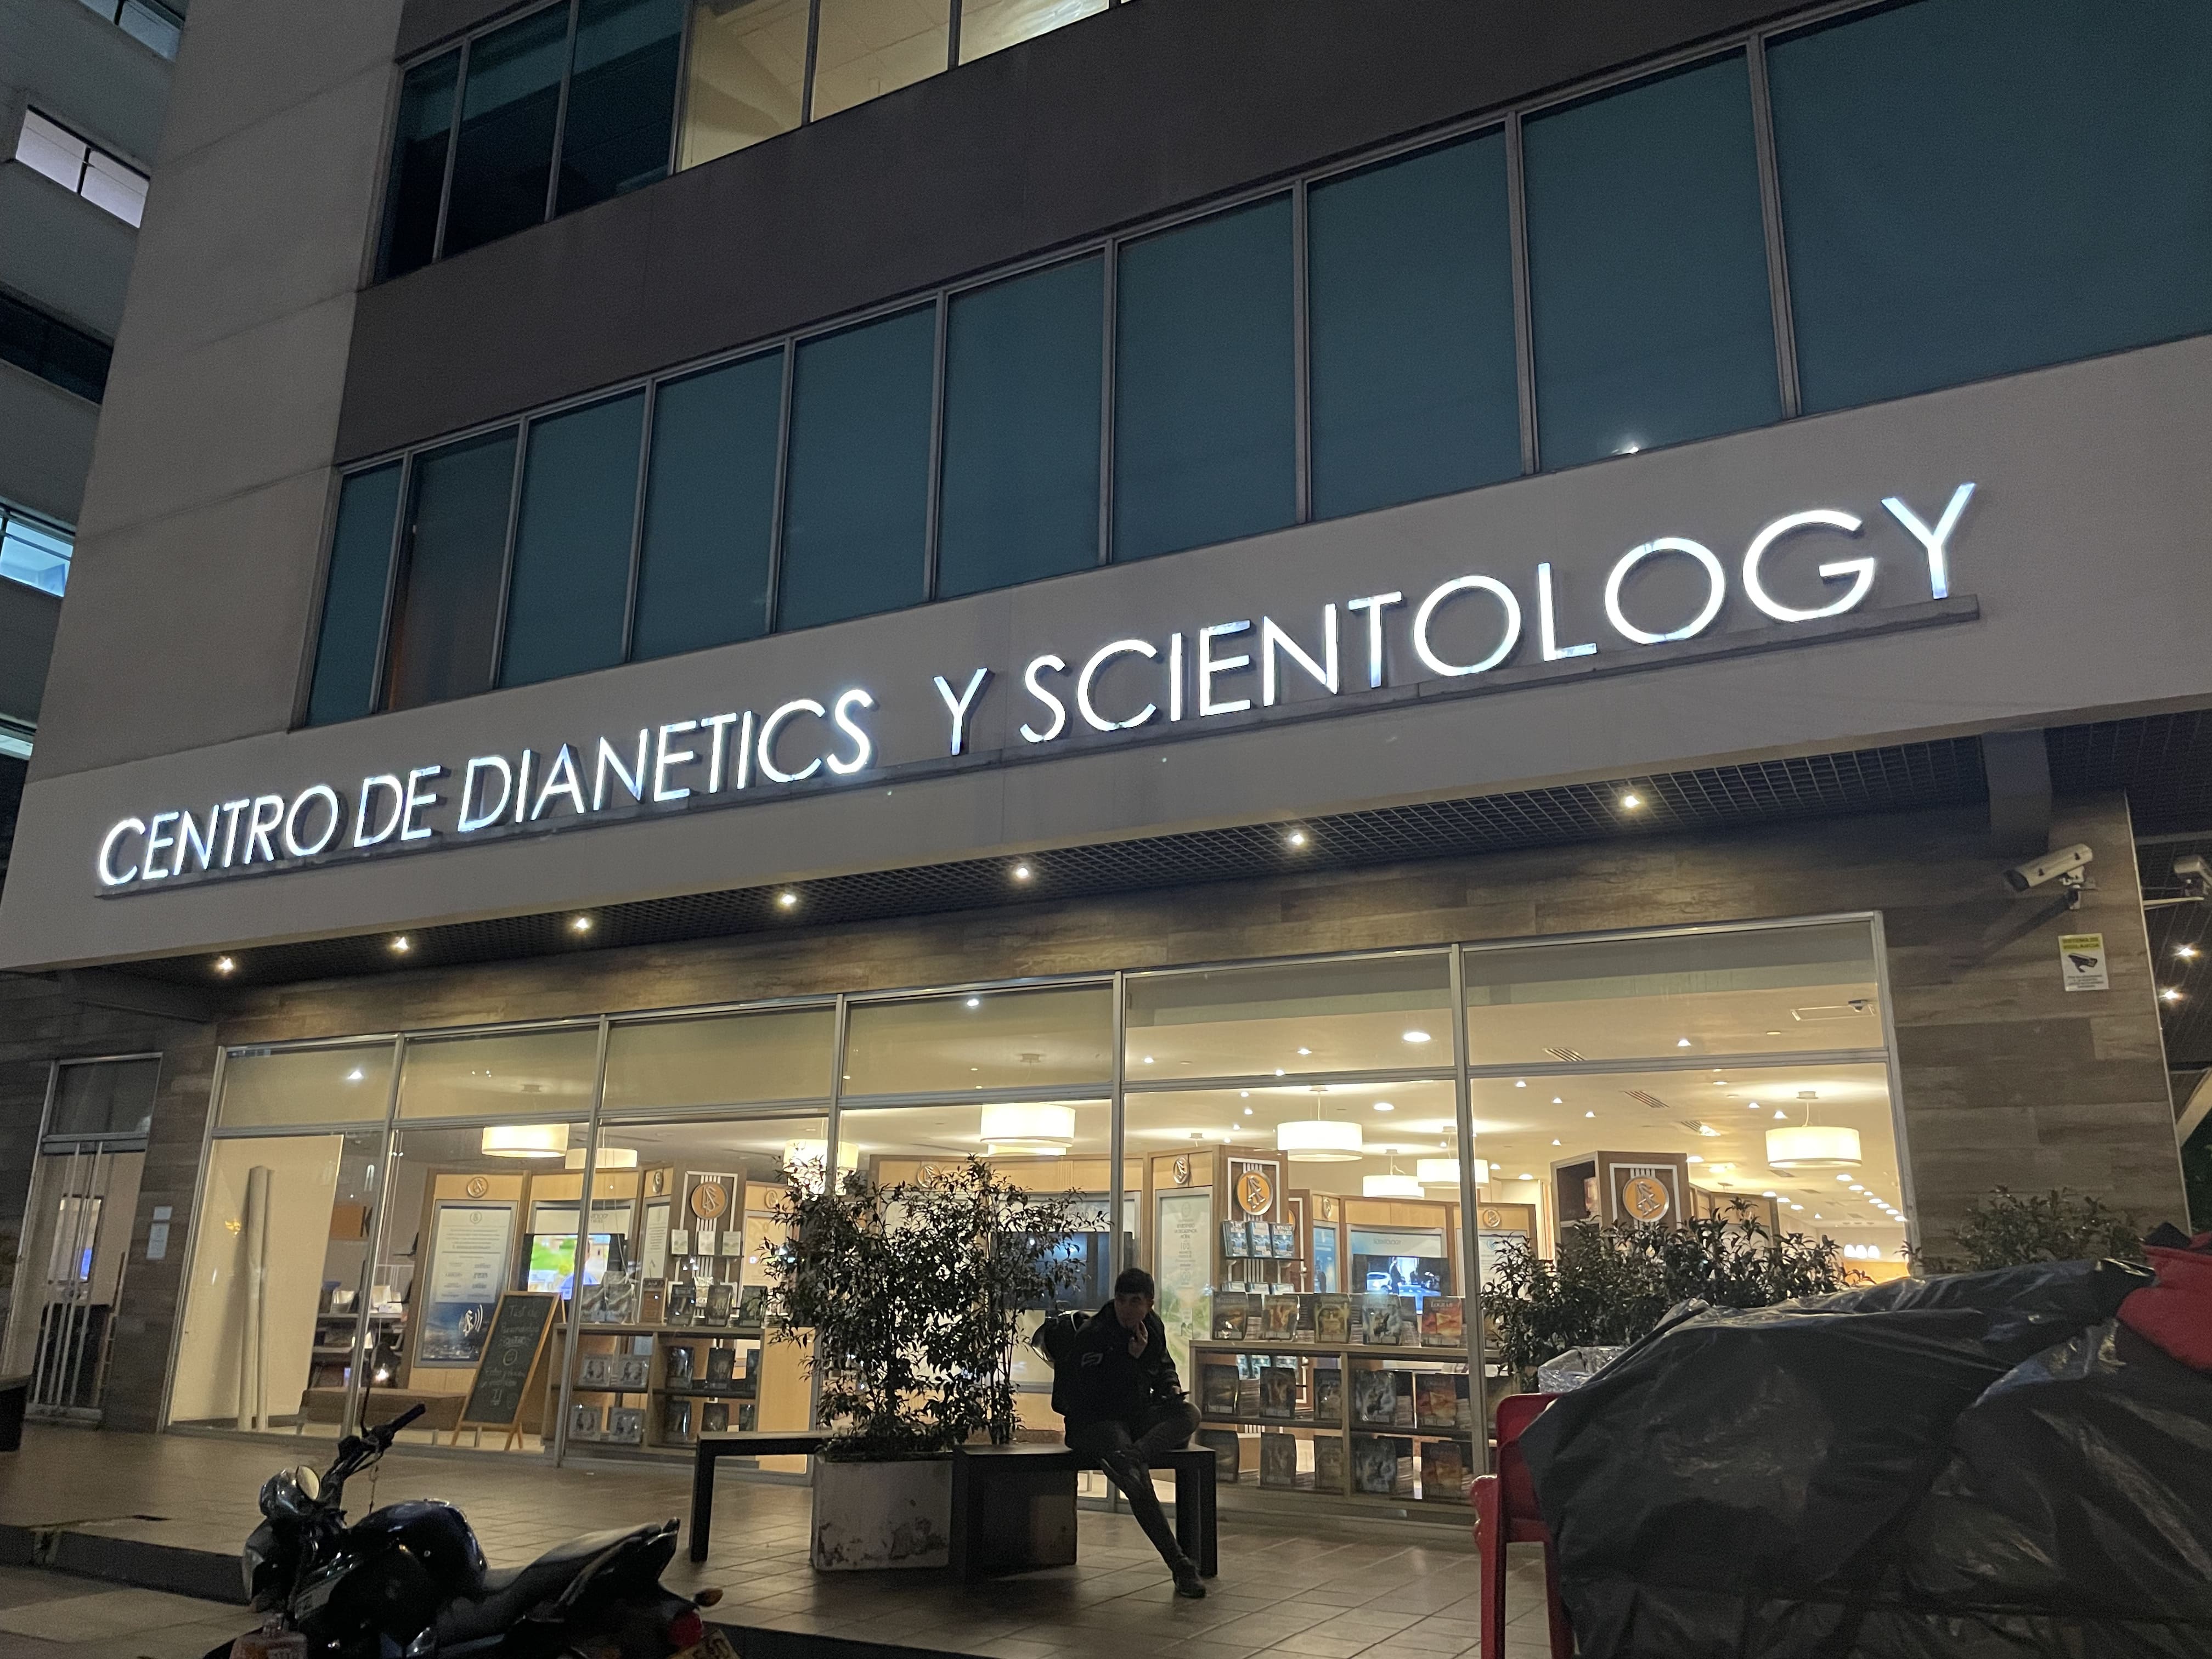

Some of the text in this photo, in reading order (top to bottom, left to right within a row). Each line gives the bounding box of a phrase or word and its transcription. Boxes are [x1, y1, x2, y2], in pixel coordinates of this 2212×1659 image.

[97, 483, 1976, 886] CENTRO DE DIANETICS Y SCIENTOLOGY
